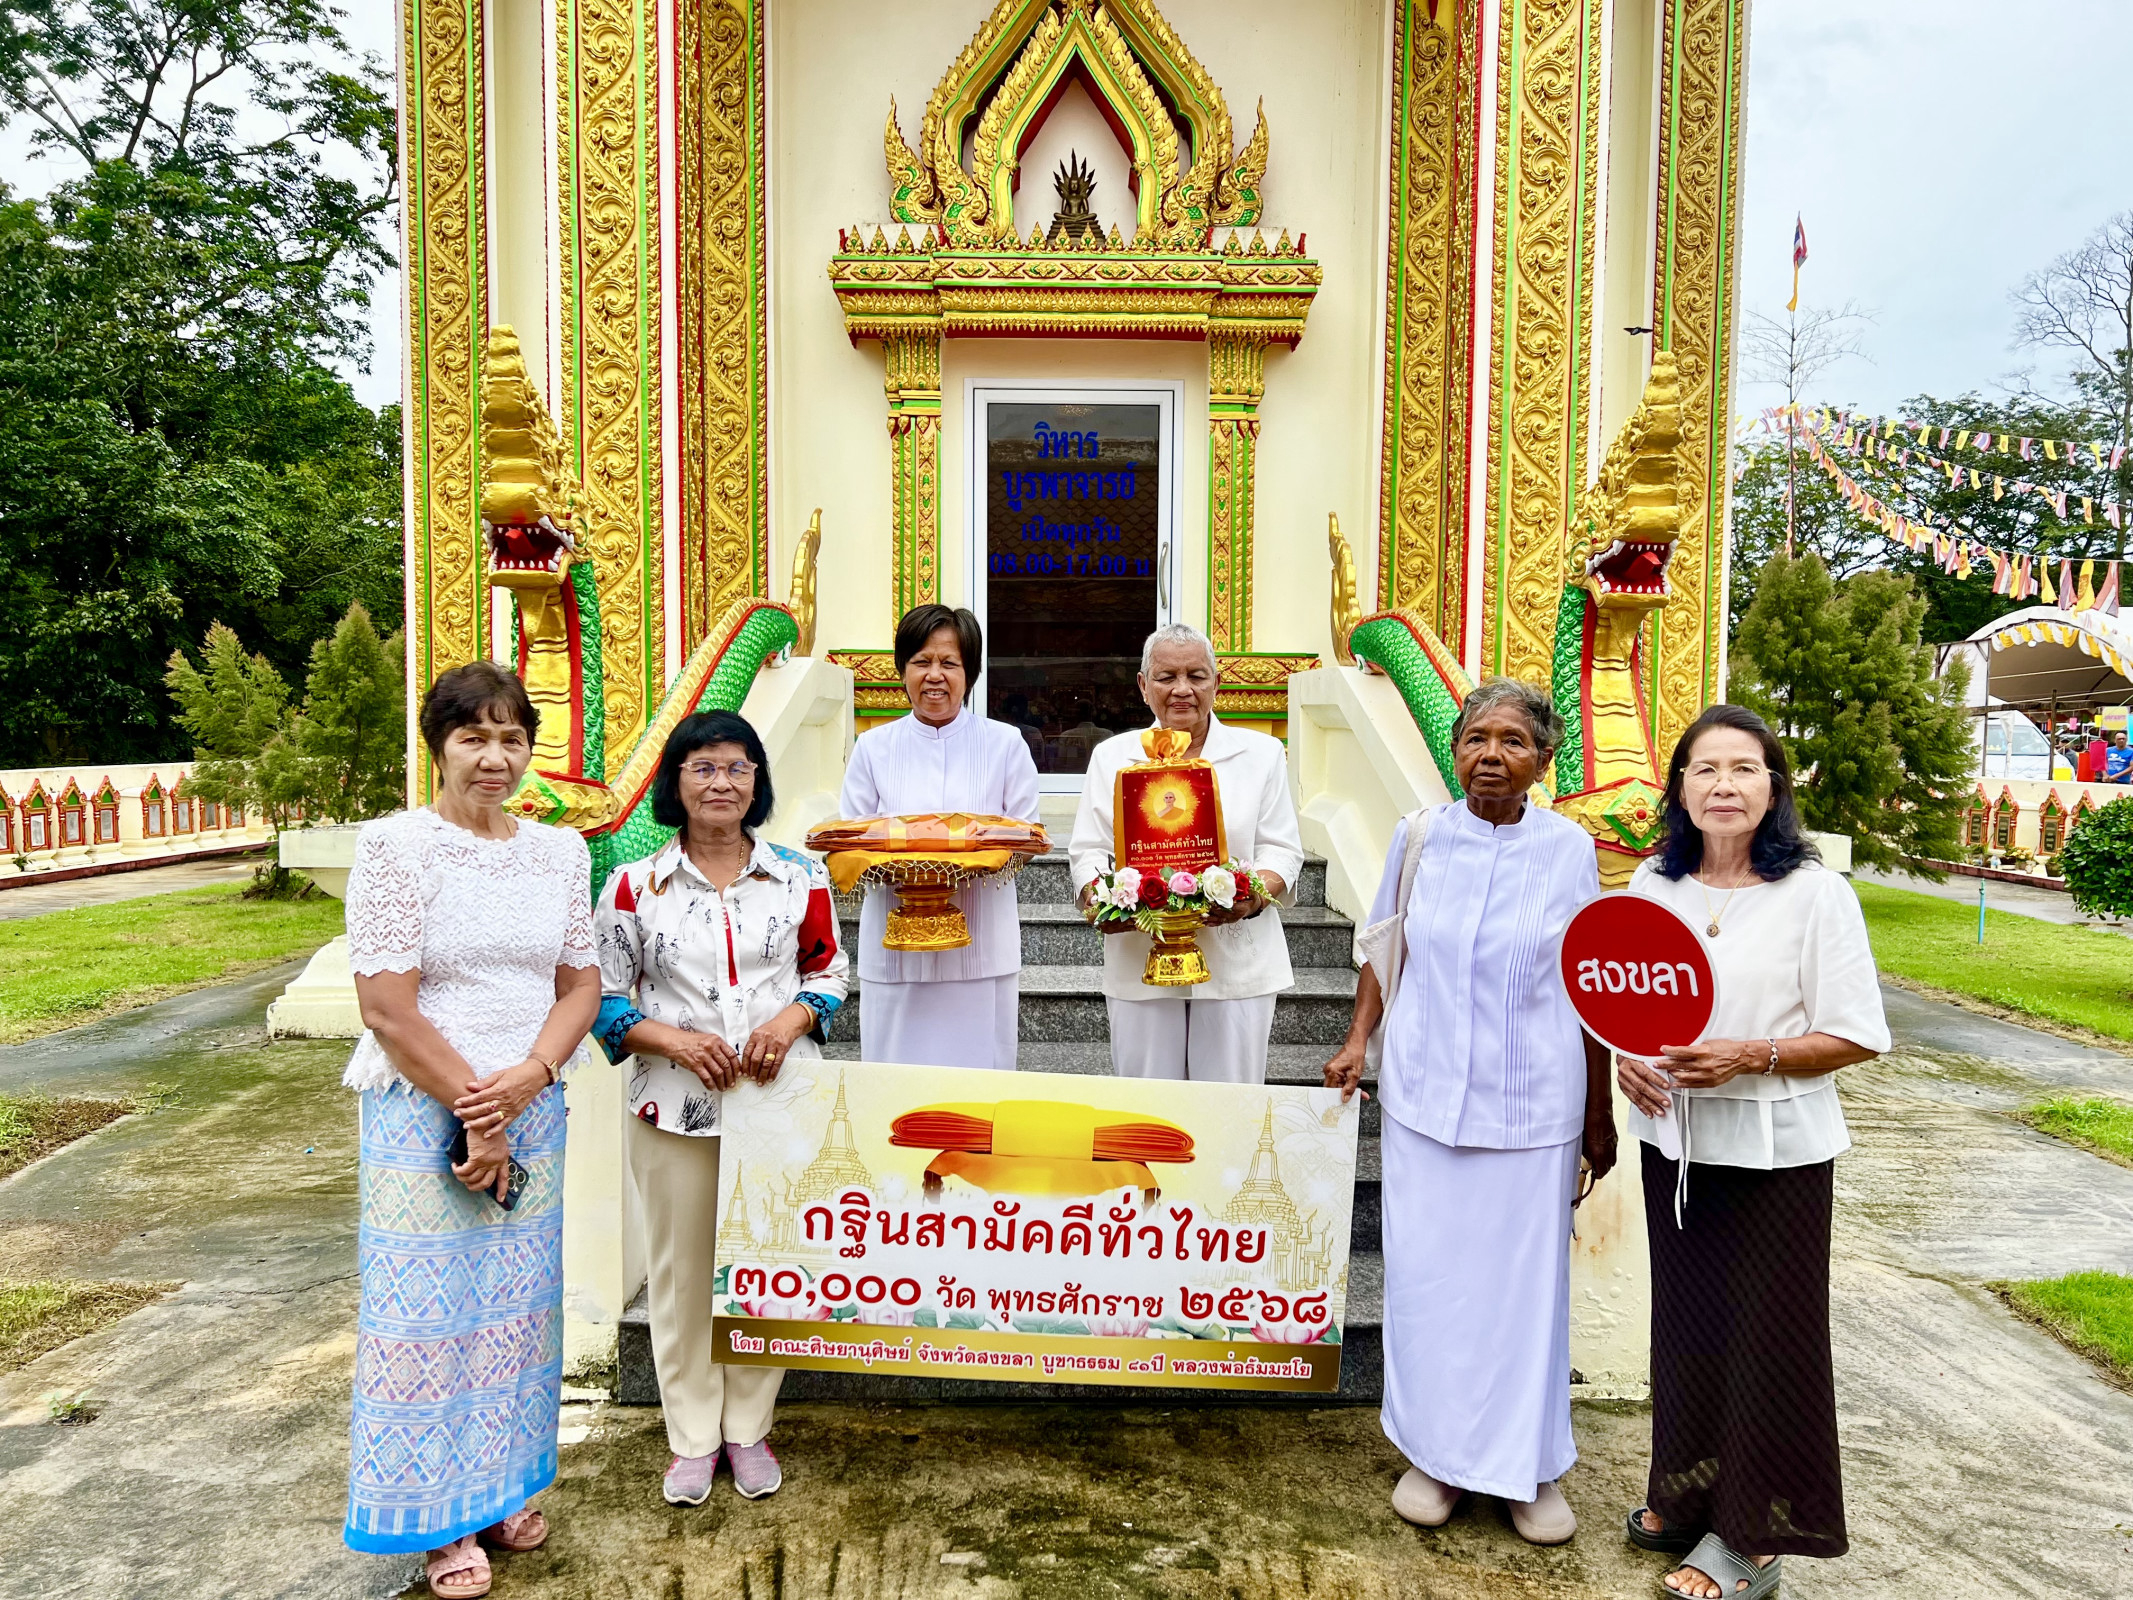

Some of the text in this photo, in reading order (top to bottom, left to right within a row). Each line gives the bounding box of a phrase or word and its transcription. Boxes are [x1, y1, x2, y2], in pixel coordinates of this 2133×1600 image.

[1034, 421, 1099, 459] วิหาร
[1002, 461, 1138, 512] บูรพาจารย์
[1021, 514, 1121, 550] เปิดทุกวัน
[989, 552, 1127, 576] 08.00-17.00
[1130, 835, 1213, 854] กฐินสามัคคีทั่วไทย
[1577, 958, 1699, 997] สงขลา
[803, 1191, 1267, 1263] กฐินสามัคคีทั่วไทย
[734, 1267, 1328, 1324] ๓๐,๐๐๐ วัด พุทธศักราช ๒๕๖๘
[731, 1332, 763, 1351] โดย
[771, 1338, 911, 1364] คณะศิษยานุศิษย์
[918, 1344, 1033, 1367] จังหวัดสงขลา
